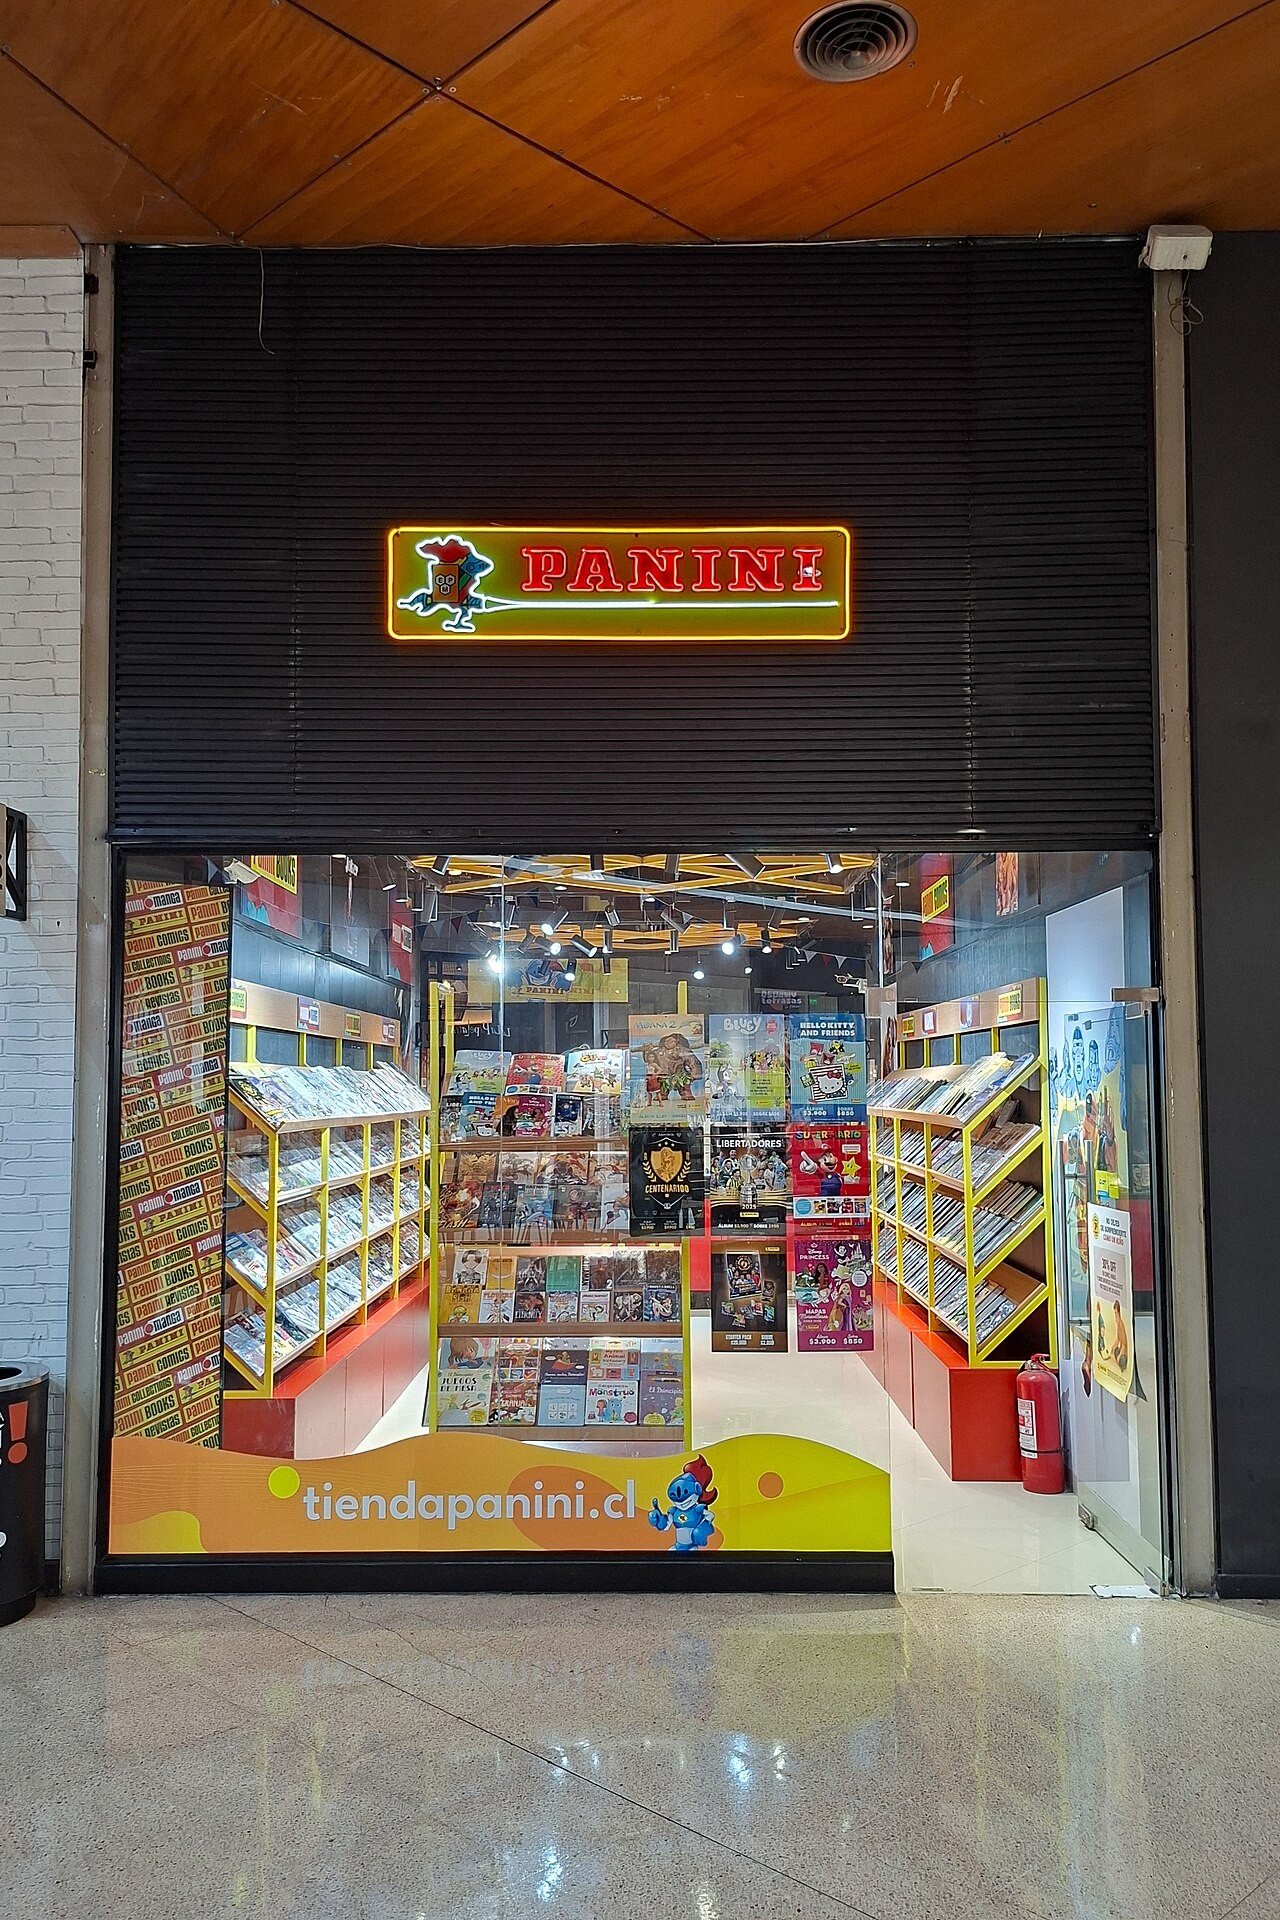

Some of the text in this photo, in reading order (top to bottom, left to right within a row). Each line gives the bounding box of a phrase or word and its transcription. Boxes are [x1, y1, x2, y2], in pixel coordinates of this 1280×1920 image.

[522, 547, 823, 593] PANINI
[139, 910, 184, 926] PANINI
[157, 930, 189, 947] COMICS
[145, 971, 175, 990] BOOKS
[724, 1017, 761, 1034] BLUEY
[137, 1052, 170, 1072] COMICS
[125, 1097, 155, 1116] BOOKS
[184, 1138, 213, 1158] BOOKS
[716, 1139, 782, 1148] LIBERTADORES
[159, 1201, 204, 1221] PANINI
[177, 1219, 208, 1241] COMICS
[165, 1264, 194, 1286] BOOKS
[606, 1279, 613, 1290] 2
[139, 1330, 184, 1354] PANINI
[157, 1348, 189, 1371] COMICS
[589, 1387, 634, 1396] Monstruo
[145, 1395, 175, 1419] BOOKS
[303, 1480, 636, 1531] tiendapanini.cl
